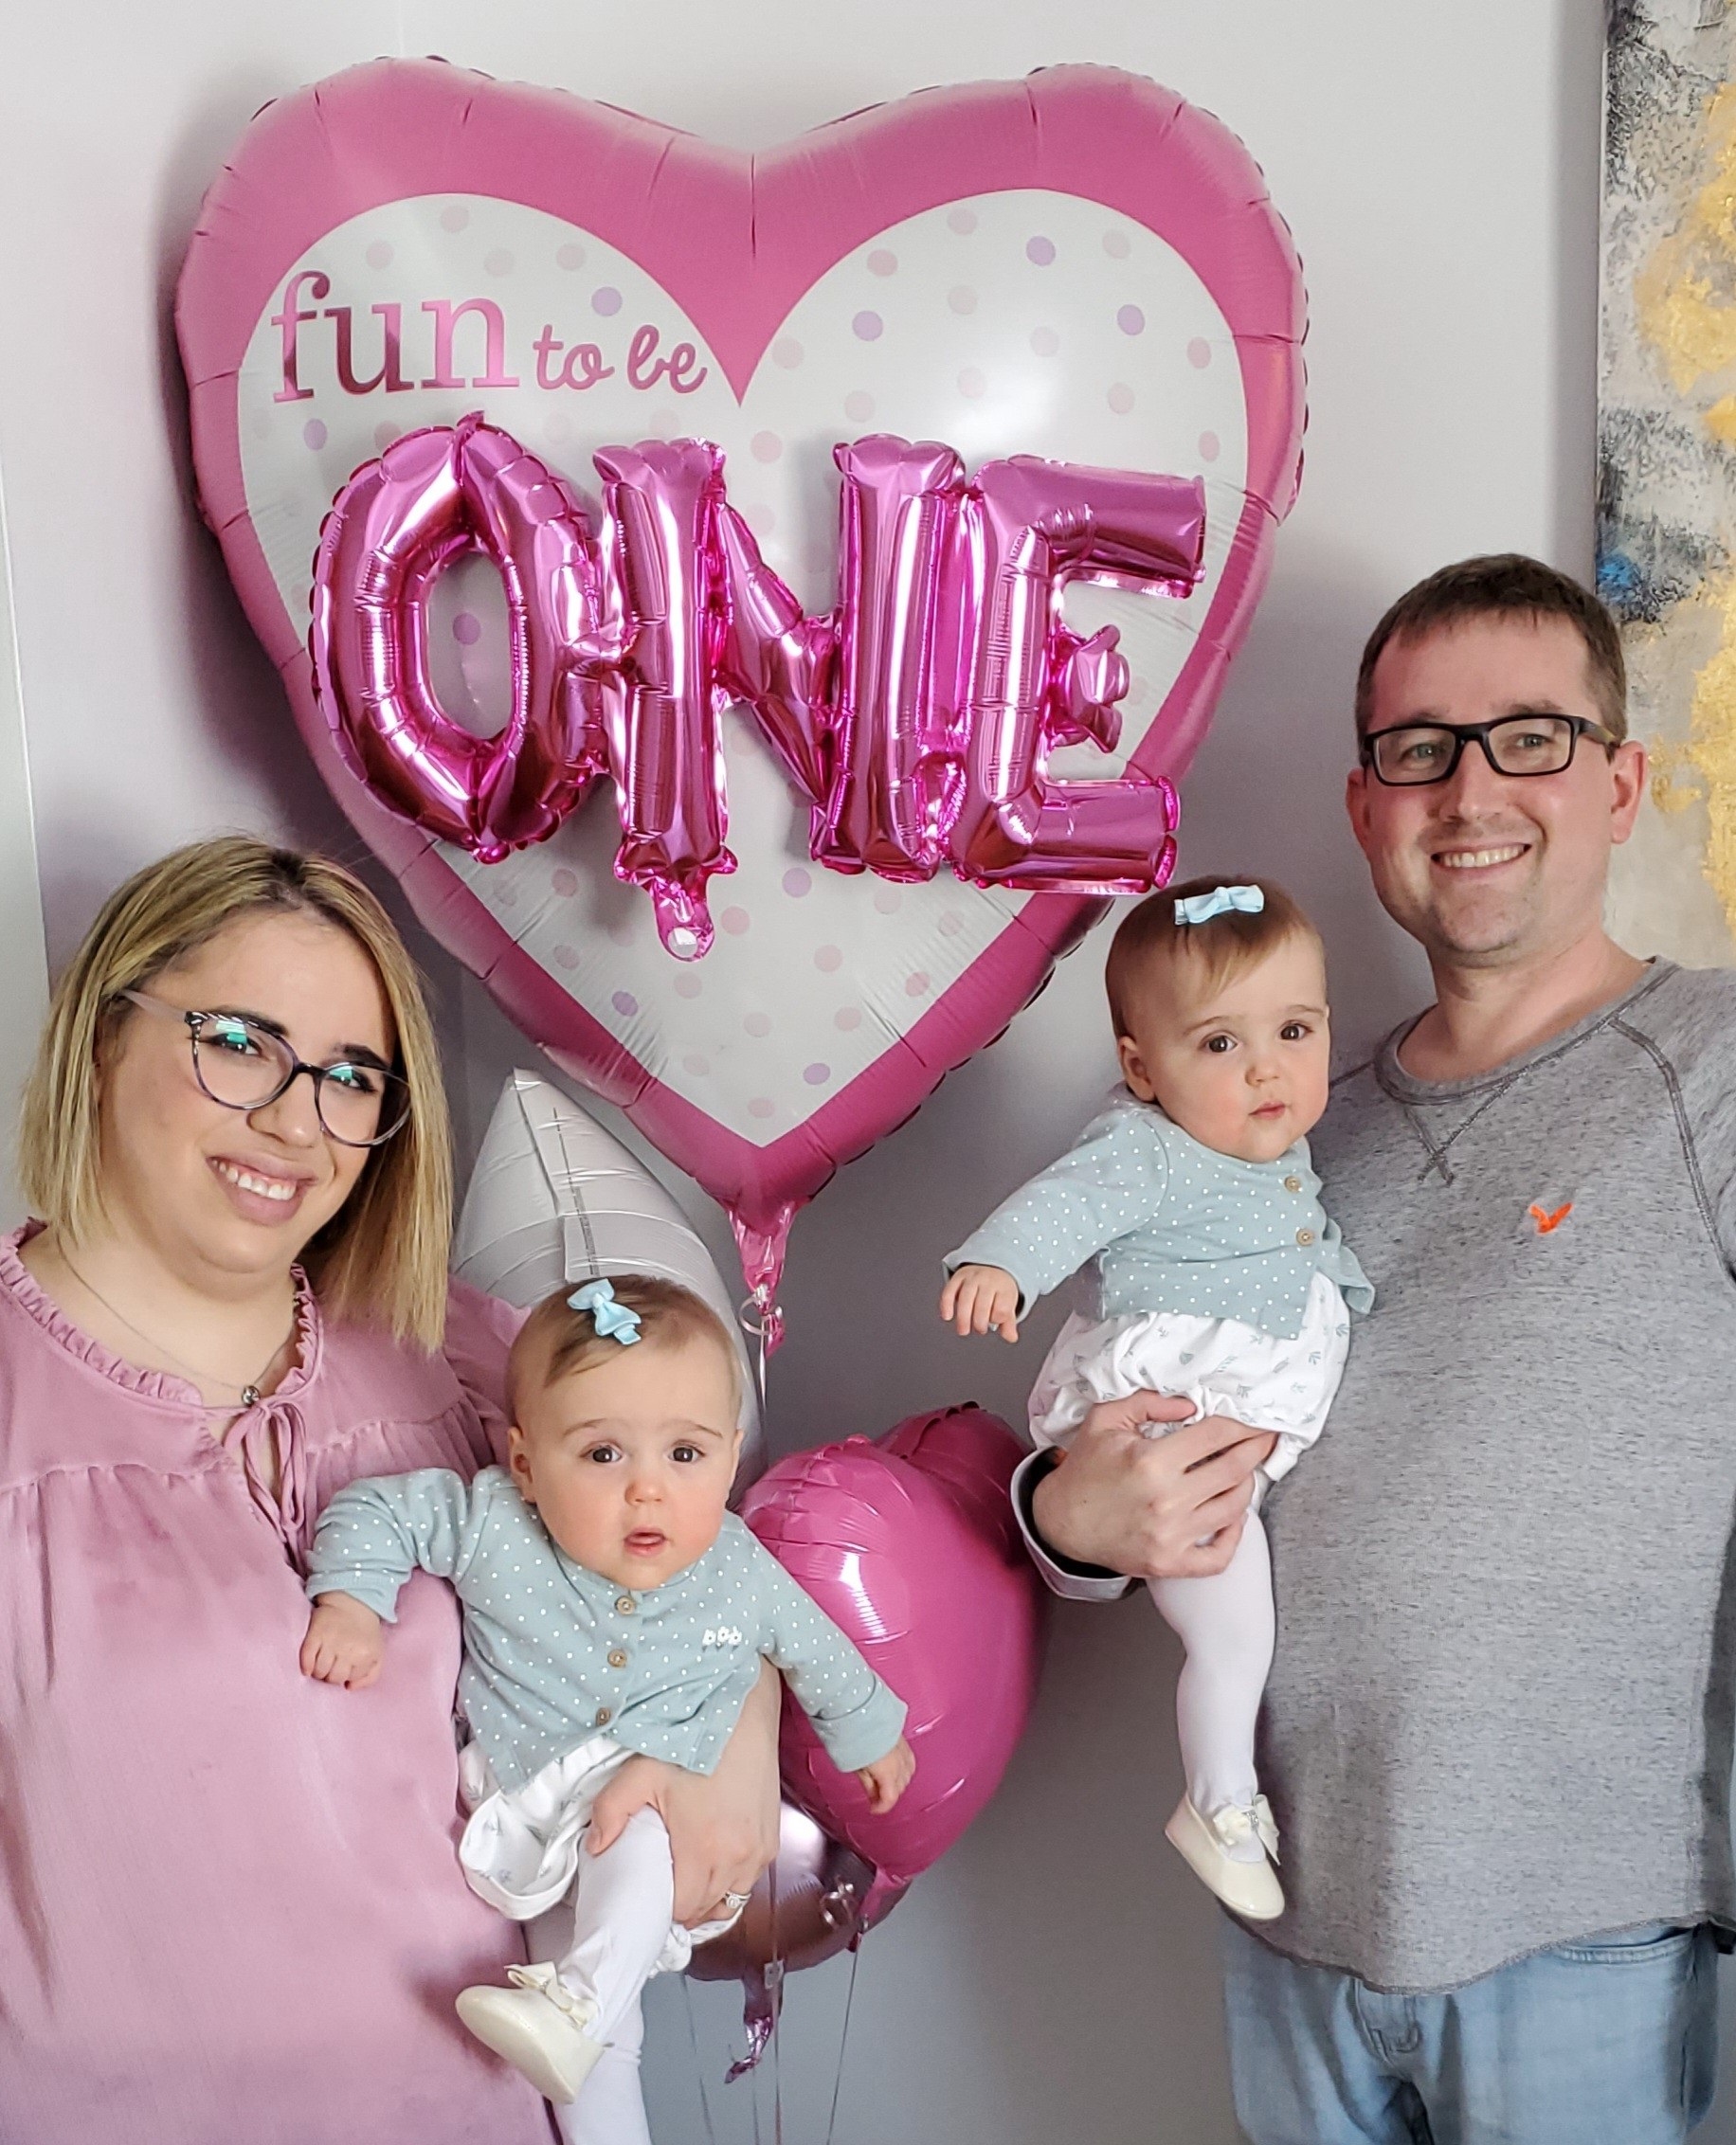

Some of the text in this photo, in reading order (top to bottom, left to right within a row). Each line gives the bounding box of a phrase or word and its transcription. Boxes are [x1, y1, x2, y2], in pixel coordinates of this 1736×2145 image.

[270, 270, 709, 404] fun to be
[311, 411, 1207, 896] ONE
